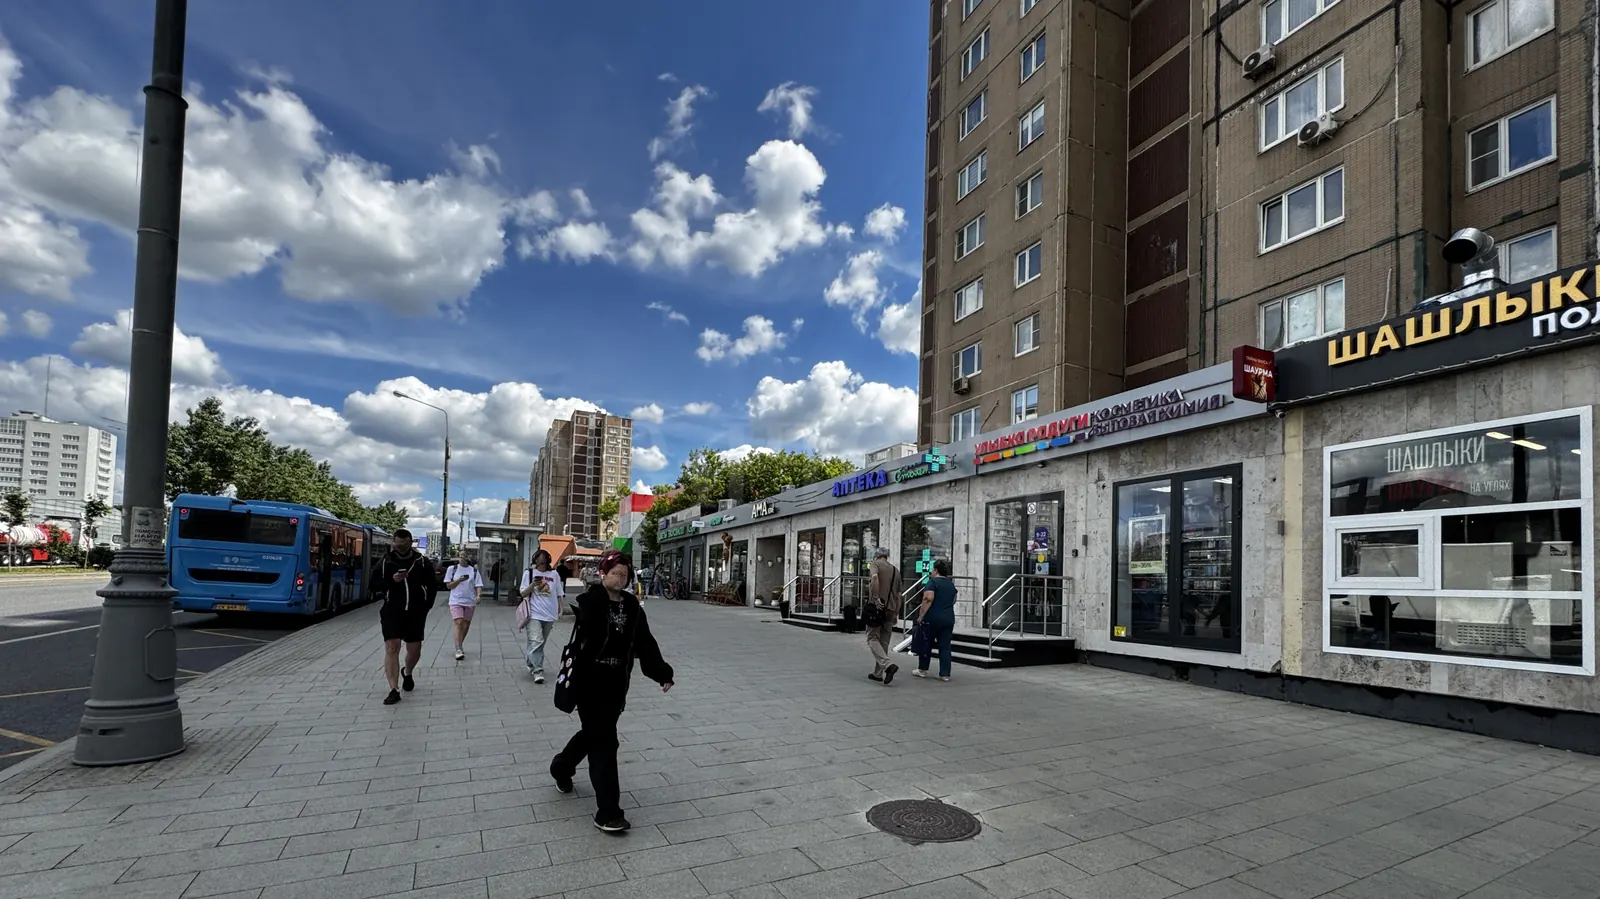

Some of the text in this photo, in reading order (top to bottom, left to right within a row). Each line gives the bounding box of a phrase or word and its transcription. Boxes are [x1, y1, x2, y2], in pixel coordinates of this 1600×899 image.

[1328, 264, 1600, 367] ШАШЛЫК
[1243, 363, 1273, 379] ШАУРМА
[1091, 394, 1225, 436] БЫТОВАЯ ХИМИЯ
[1092, 388, 1184, 421] КОСМЕТИКА
[1026, 412, 1090, 441] РАДУГИ
[1386, 436, 1485, 473] ШАШЛЫКИ
[831, 470, 887, 497] АПТЕКА
[1470, 479, 1511, 494] НА УГЛЯХ
